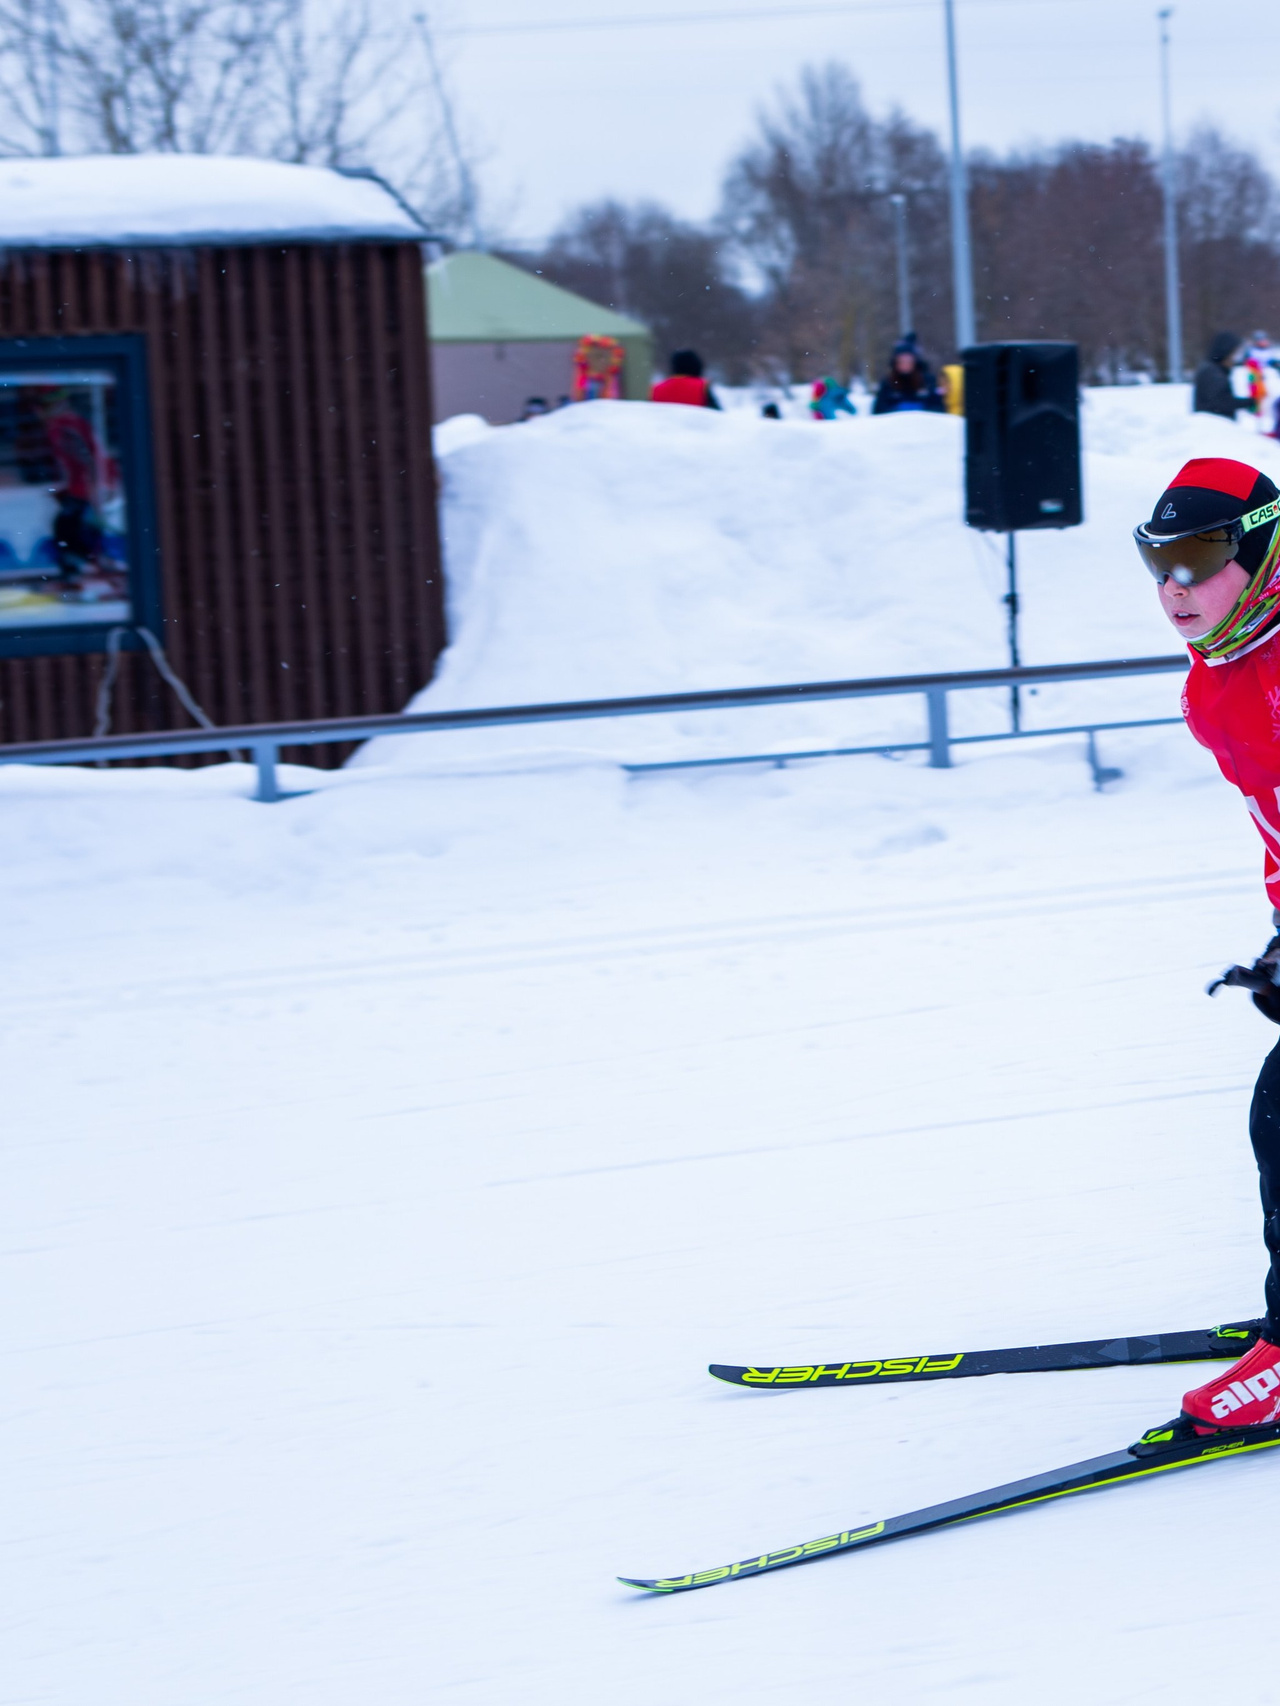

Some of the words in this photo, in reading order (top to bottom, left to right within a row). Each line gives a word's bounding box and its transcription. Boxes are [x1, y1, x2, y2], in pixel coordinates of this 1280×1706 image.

[742, 1353, 965, 1383] FISCHER
[1201, 1440, 1244, 1456] FISCHER
[655, 1520, 885, 1588] FISCHER
